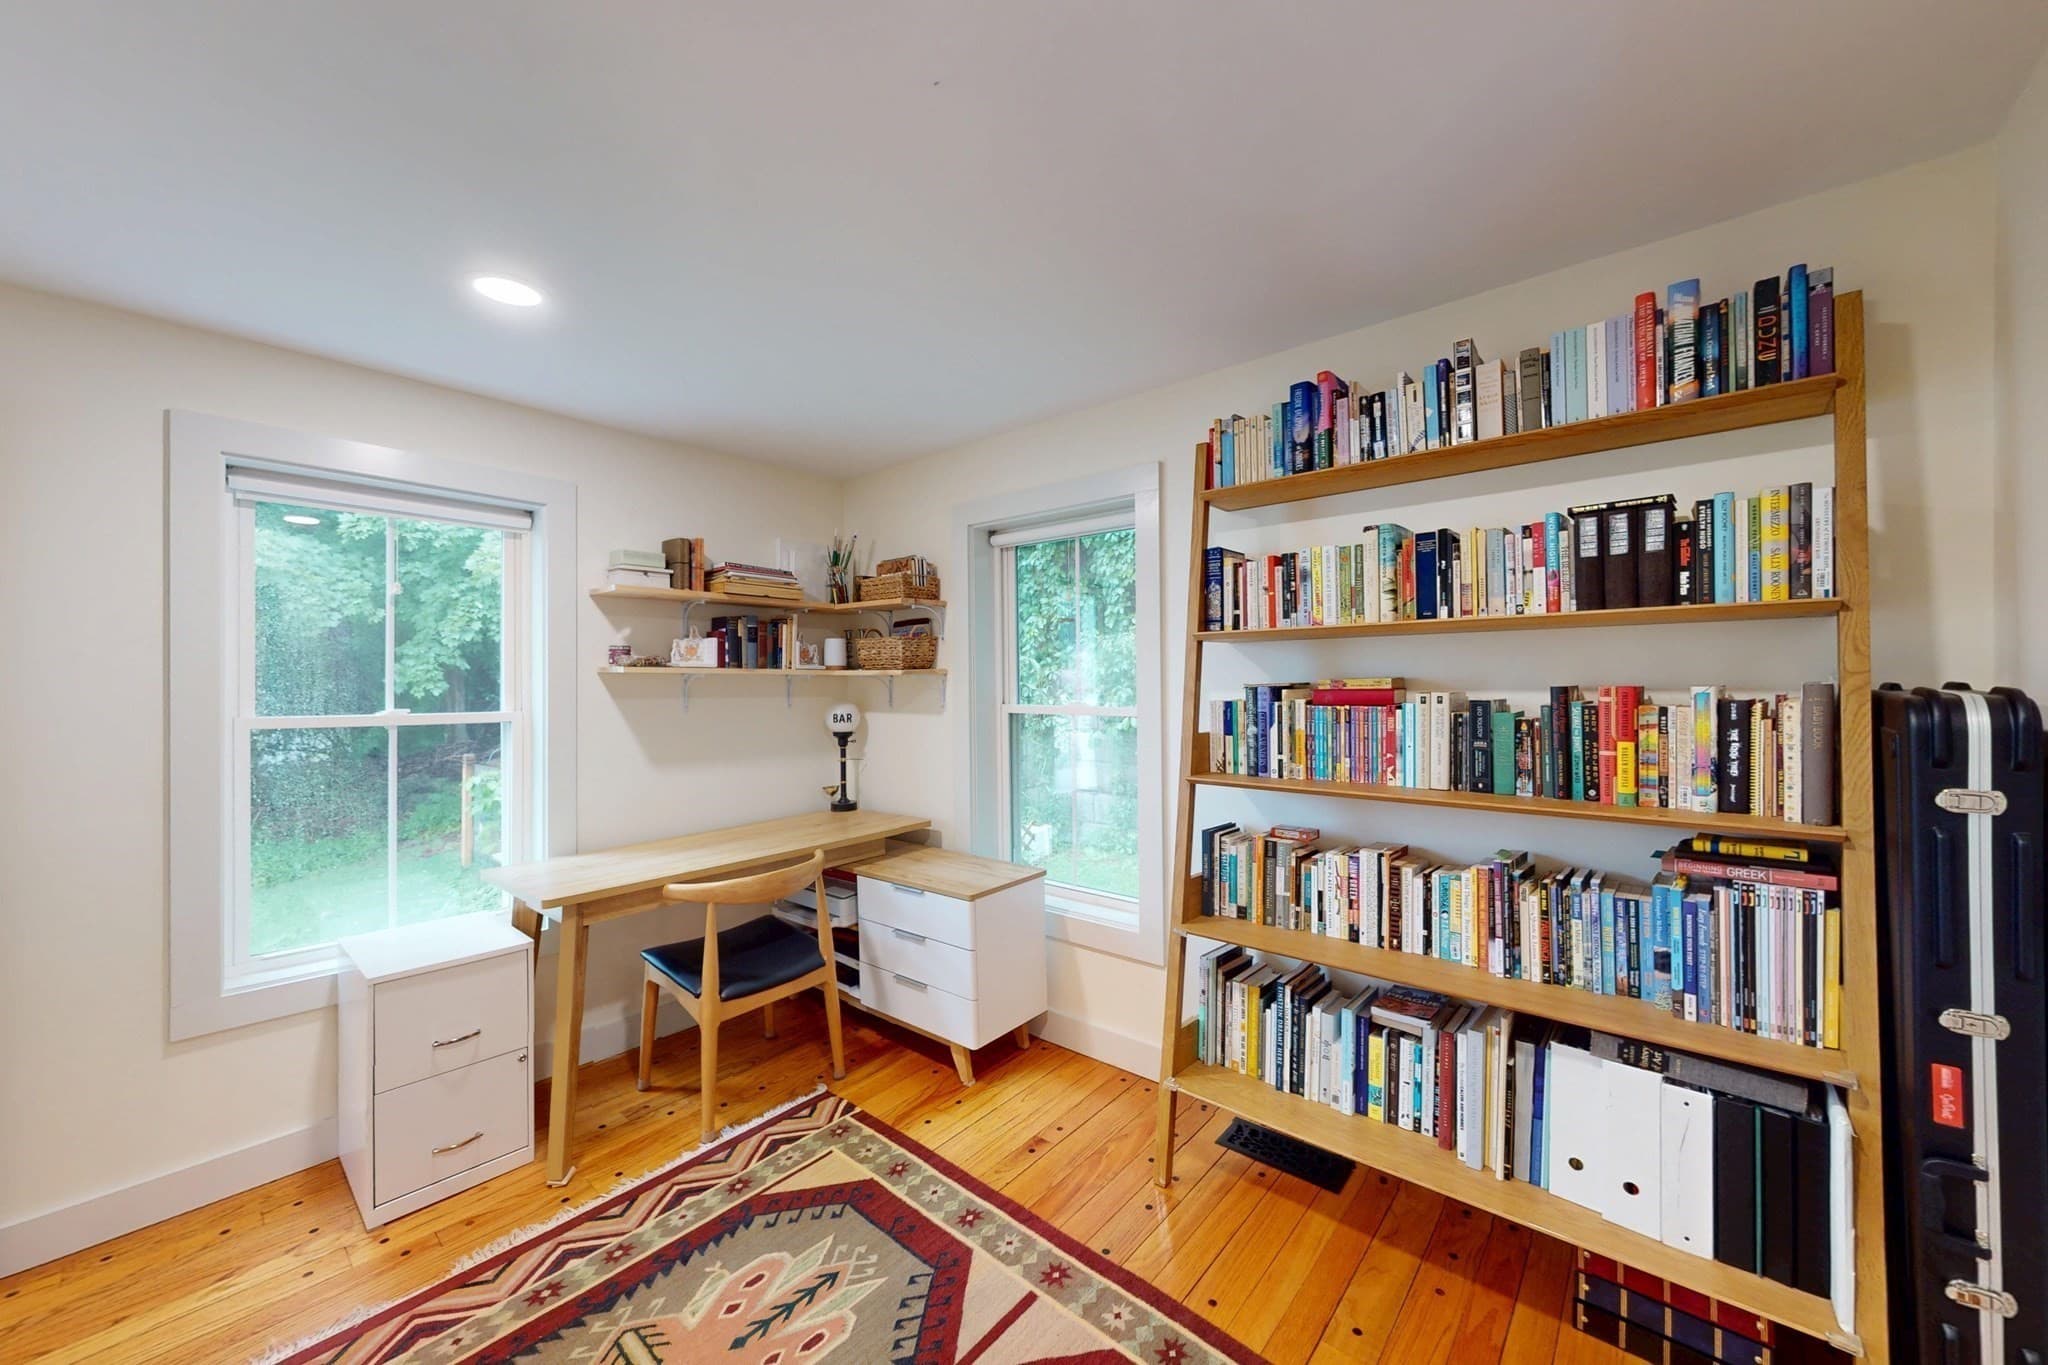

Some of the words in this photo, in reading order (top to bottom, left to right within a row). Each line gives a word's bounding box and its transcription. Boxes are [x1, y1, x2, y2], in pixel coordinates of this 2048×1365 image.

[1674, 347, 1695, 388] FRANZEN
[1698, 505, 1706, 529] EVELYN
[1769, 489, 1781, 537] INTERMEZZO
[1769, 547, 1781, 569] SALLY
[1769, 571, 1781, 600] ROONEY
[833, 713, 852, 723] BAR
[1728, 742, 1741, 759] BOOK
[1591, 742, 1599, 783] PROJECT
[1727, 760, 1739, 777] THIEF
[1349, 861, 1357, 878] JOHN
[1678, 861, 1723, 874] BEGINNING
[1726, 866, 1768, 881] GREEK
[1349, 879, 1357, 900] GREEN
[1696, 908, 1707, 922] Easy
[1603, 927, 1614, 952] NORTH
[1698, 924, 1708, 945] French
[1699, 949, 1707, 989] STEP-BY-STEP
